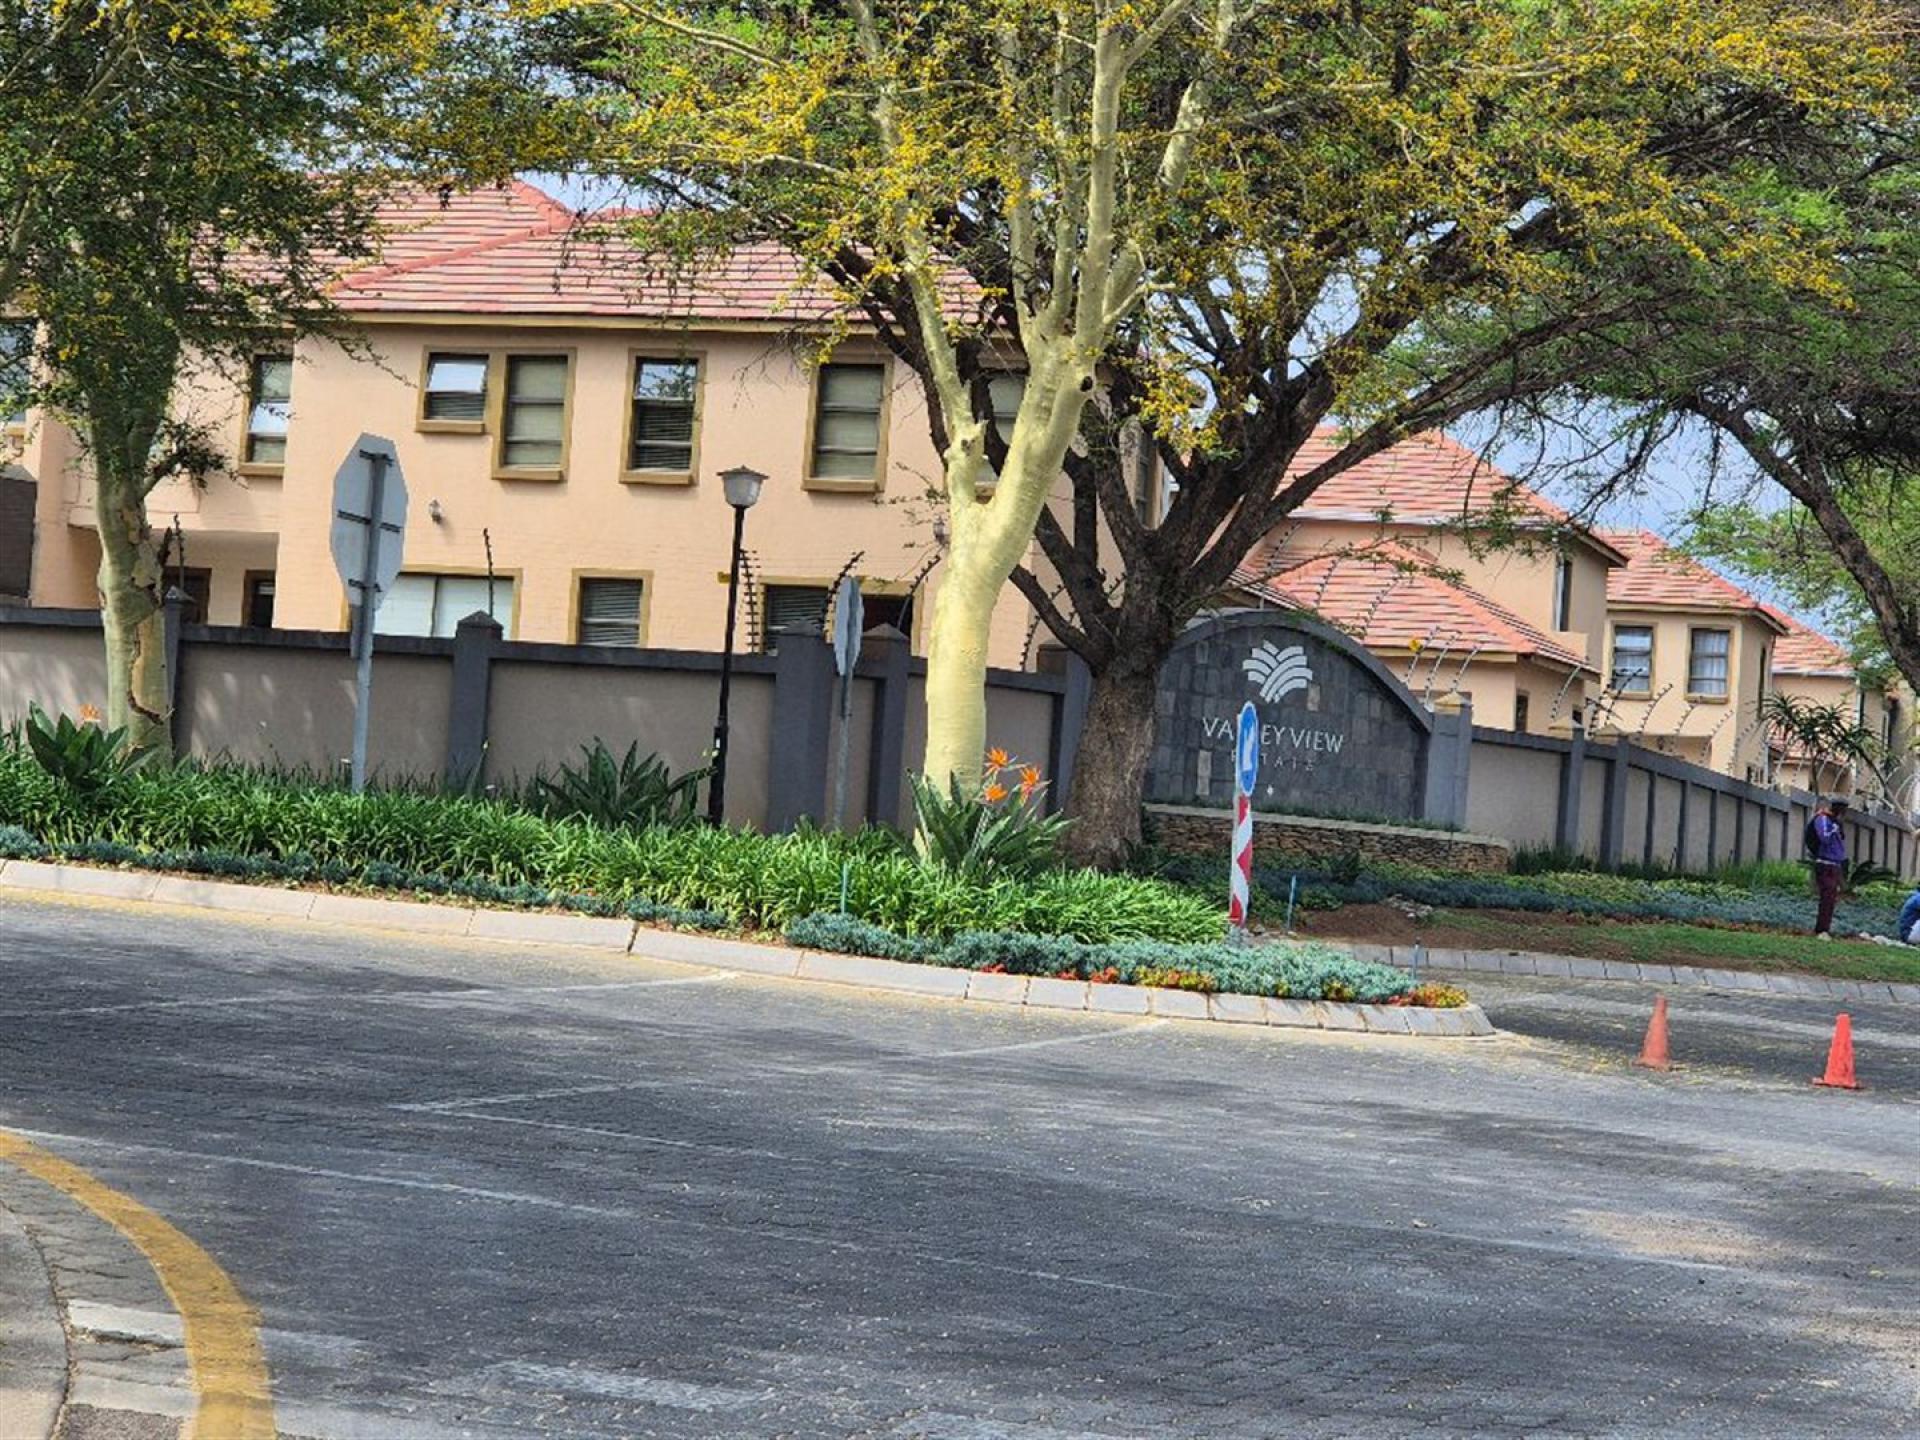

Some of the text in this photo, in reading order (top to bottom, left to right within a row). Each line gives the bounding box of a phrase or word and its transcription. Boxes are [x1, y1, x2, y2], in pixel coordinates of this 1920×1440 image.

[1202, 717, 1344, 753] VAEY VIEW
[1231, 750, 1314, 771] ETATE
